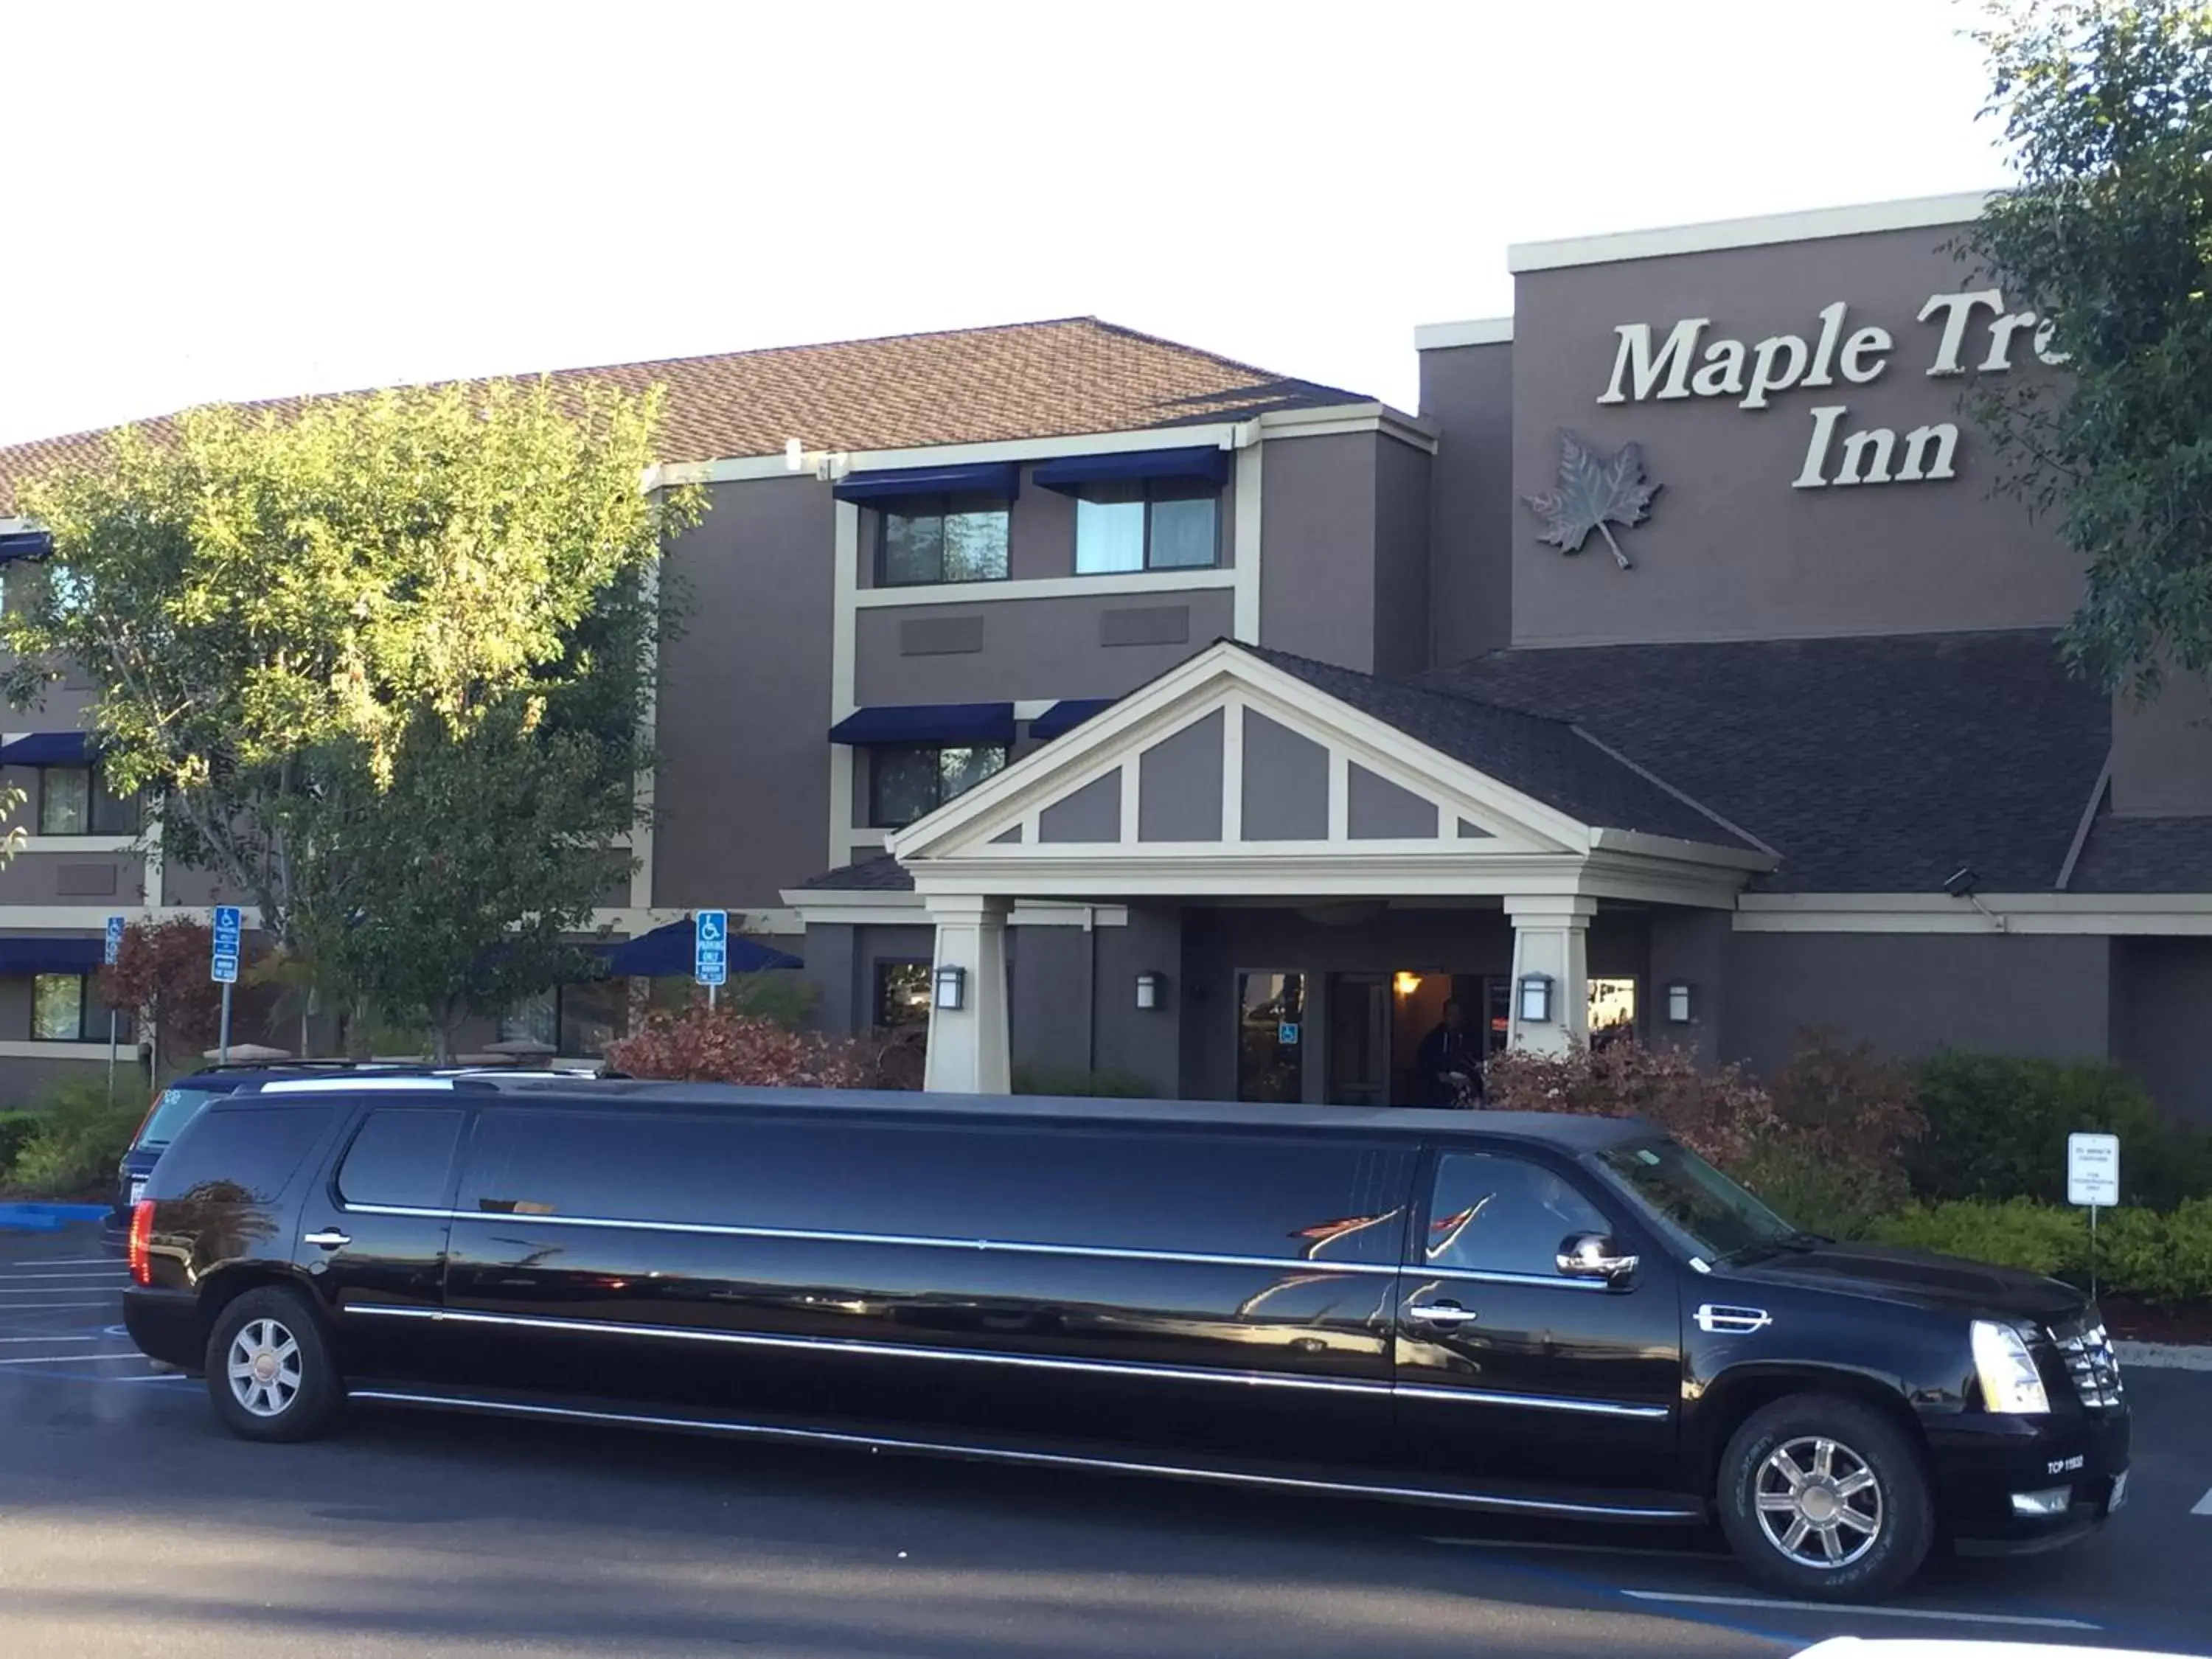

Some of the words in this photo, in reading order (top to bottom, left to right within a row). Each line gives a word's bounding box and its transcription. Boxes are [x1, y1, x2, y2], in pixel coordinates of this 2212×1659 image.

[1596, 301, 1894, 409] Maple
[1917, 288, 2075, 375] Tre
[1792, 406, 1959, 489] Inn
